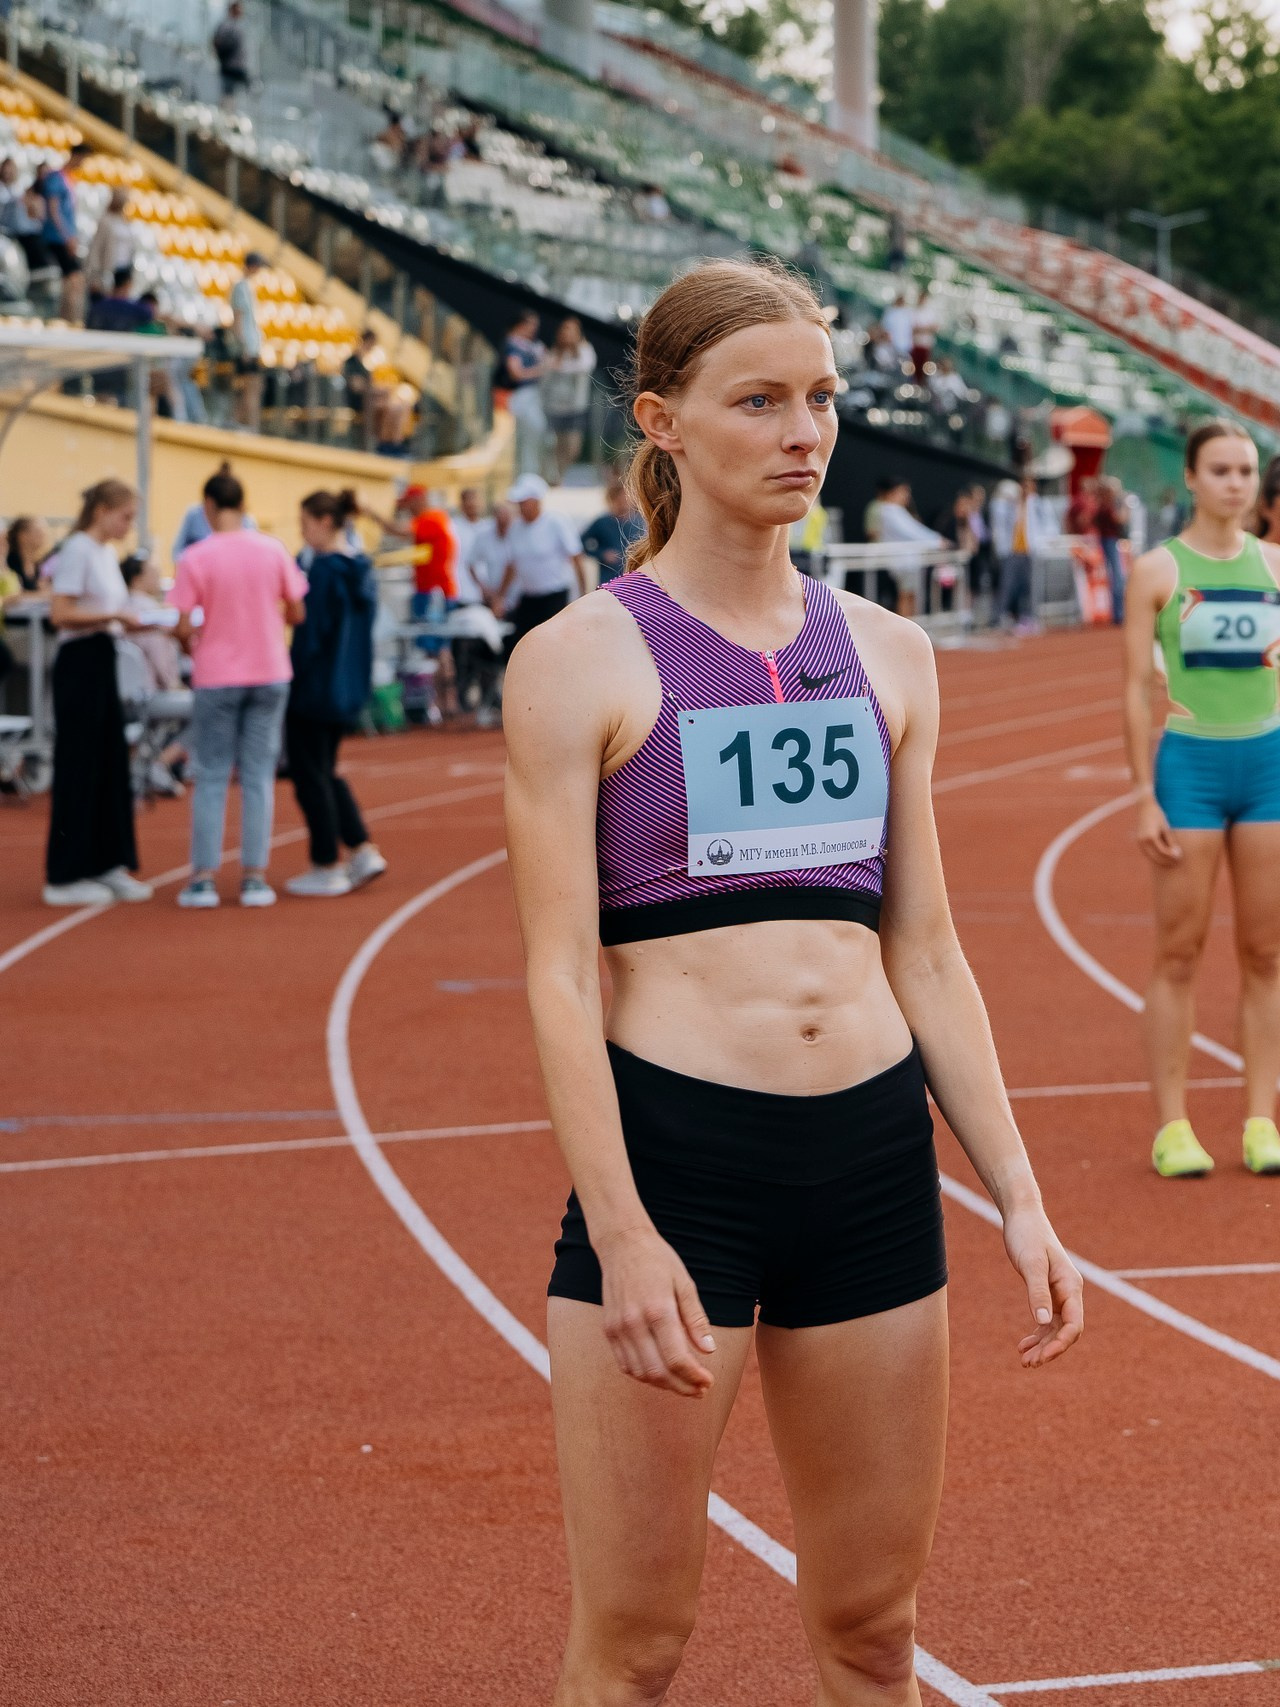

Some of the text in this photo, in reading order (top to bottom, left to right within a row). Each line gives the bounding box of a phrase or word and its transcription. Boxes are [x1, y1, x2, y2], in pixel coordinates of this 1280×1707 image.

[1213, 615, 1256, 641] 20
[719, 723, 859, 807] 135
[739, 839, 867, 861] МГУ имени М.В. Ломоносова
